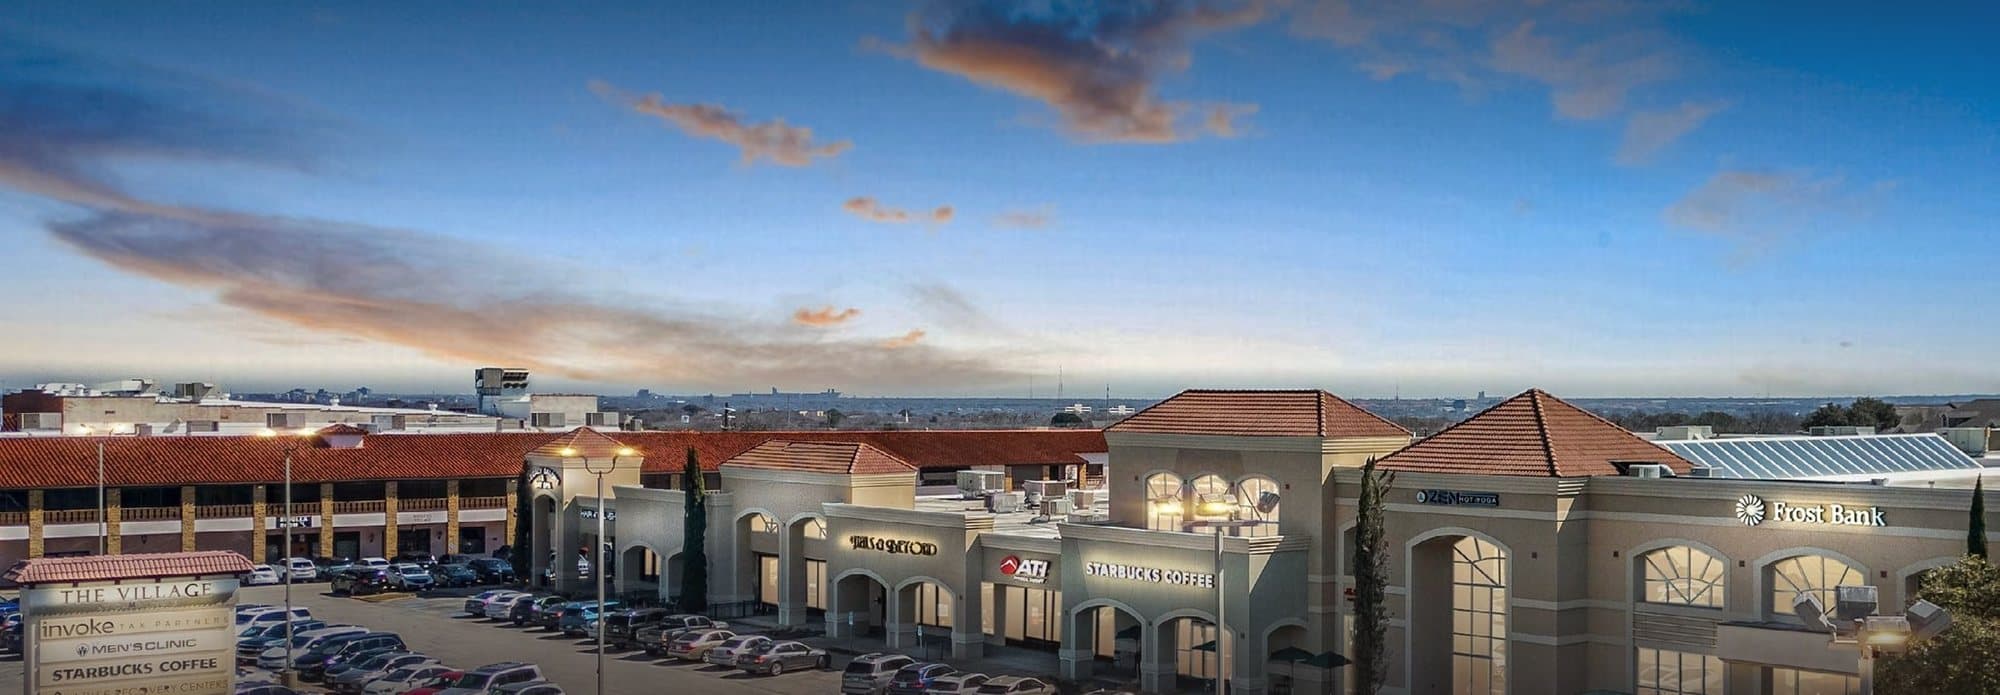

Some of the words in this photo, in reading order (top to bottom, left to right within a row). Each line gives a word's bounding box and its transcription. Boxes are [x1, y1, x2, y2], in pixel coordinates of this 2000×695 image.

[1773, 502, 1825, 523] Frost
[1830, 504, 1886, 526] Bank
[1015, 559, 1049, 577] ATI
[1086, 562, 1161, 582] STARBUCKS
[1164, 570, 1215, 588] COFFEE
[60, 588, 105, 604] THE
[117, 583, 212, 601] VILLAGE
[42, 618, 114, 637] invoke
[119, 623, 145, 631] TAX
[155, 616, 228, 627] PARTNERS
[92, 642, 143, 655] MEN'S
[144, 639, 197, 651] CLINIC
[52, 663, 153, 681] STARBUCKS
[160, 658, 218, 672] COFFEE
